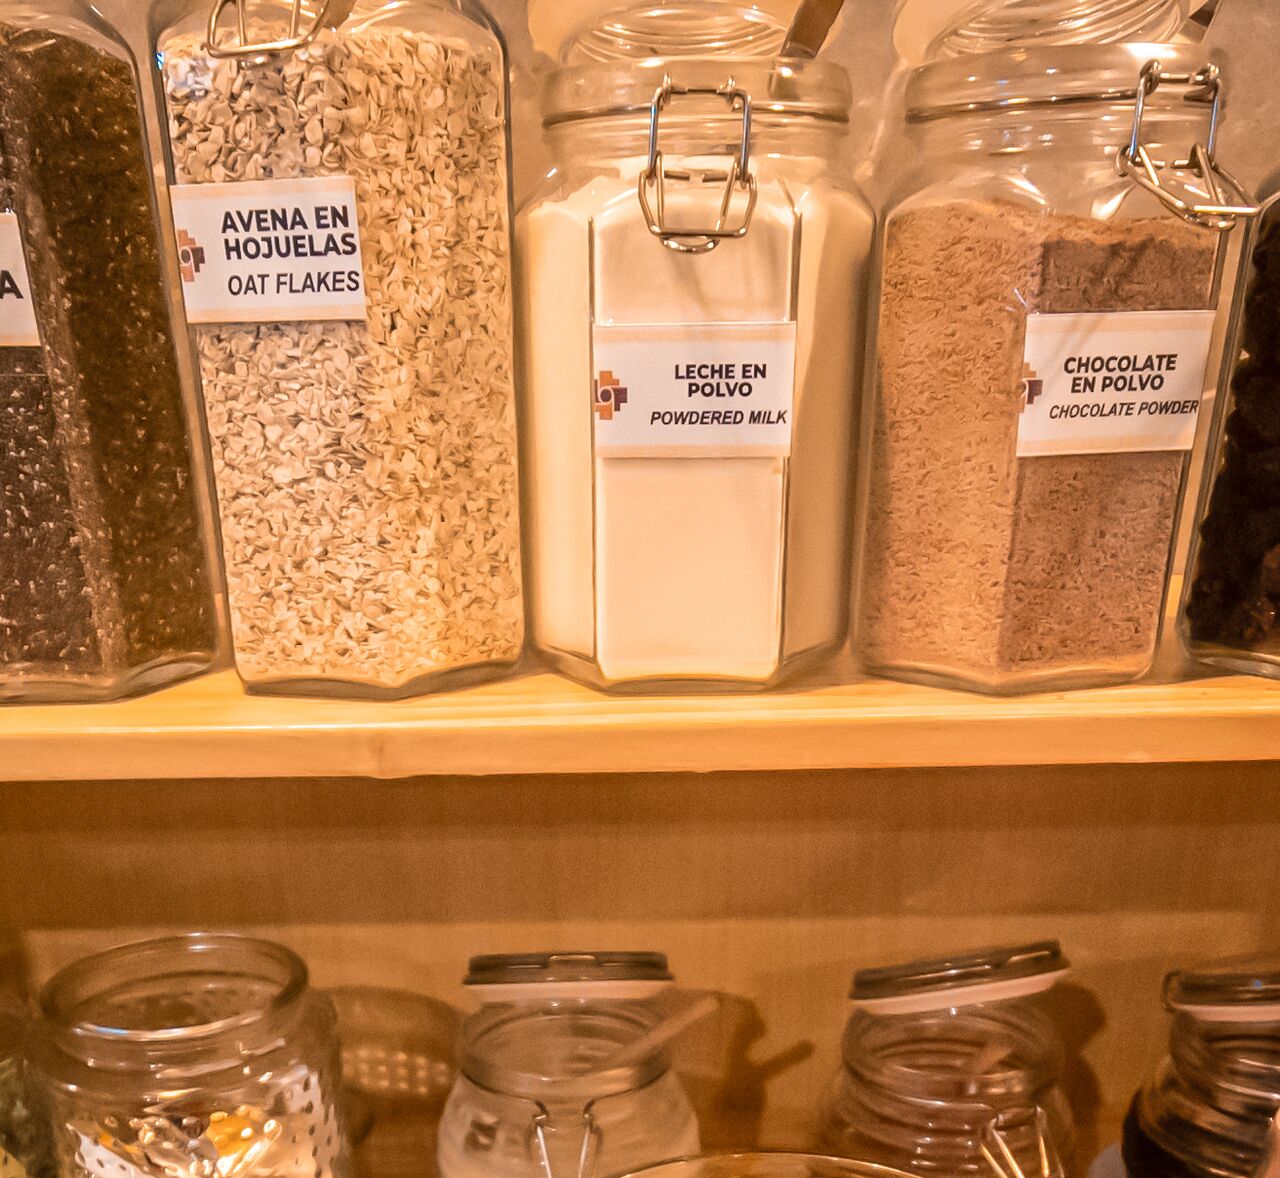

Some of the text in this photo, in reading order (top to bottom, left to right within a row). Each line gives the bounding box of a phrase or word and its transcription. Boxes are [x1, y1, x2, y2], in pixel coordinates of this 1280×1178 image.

[221, 205, 349, 234] AVENA EN
[224, 232, 357, 260] HOJUELAS
[228, 270, 360, 296] OAT FLAKES
[674, 363, 767, 379] LECHE EN
[1063, 353, 1178, 374] CHOCOLATE
[688, 381, 753, 398] POLVO
[1070, 374, 1165, 394] EN POLVO
[650, 409, 788, 425] POWDERED MILK
[1049, 400, 1199, 419] CHOCOLATE POWDER
